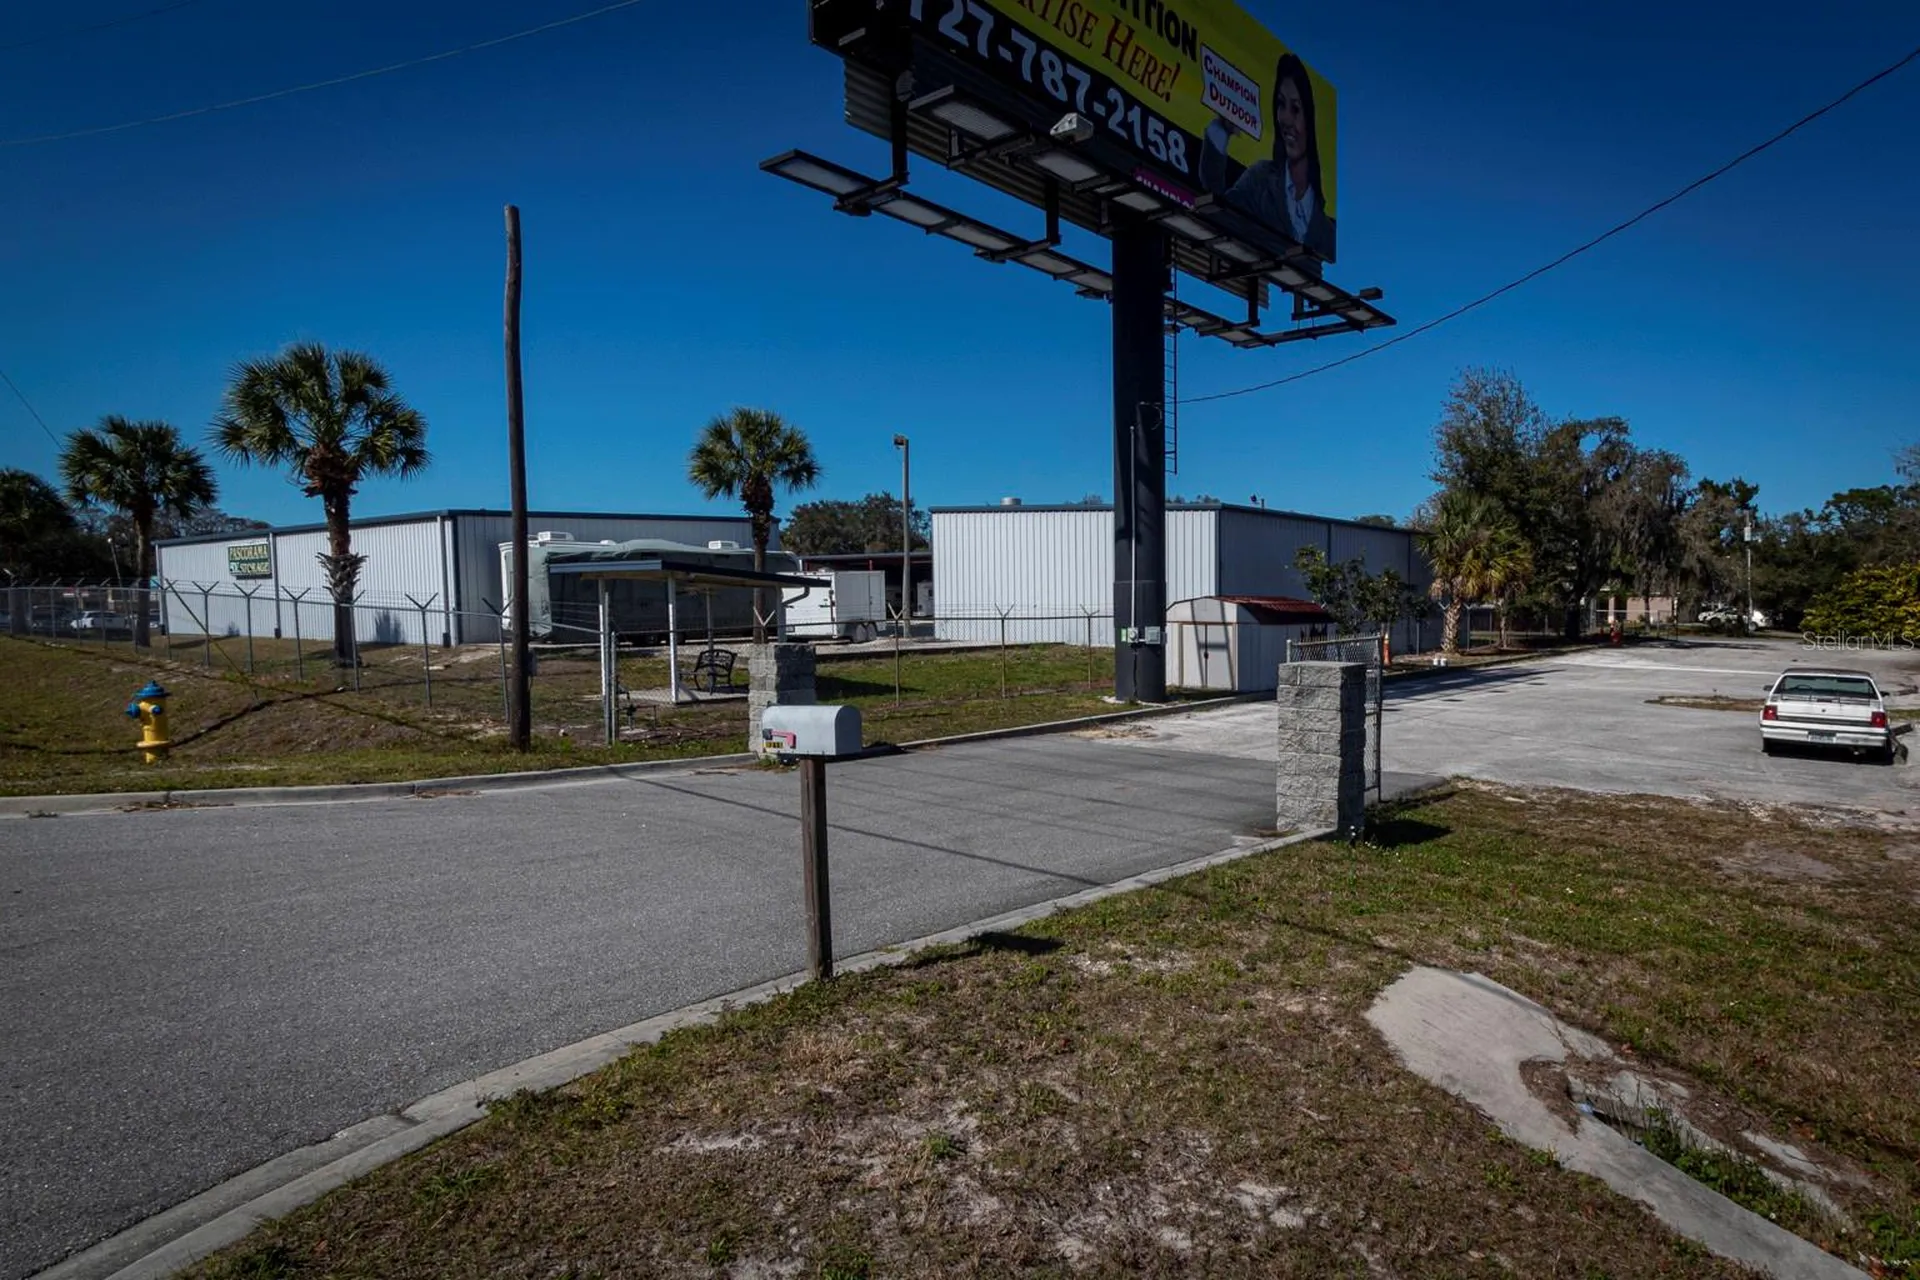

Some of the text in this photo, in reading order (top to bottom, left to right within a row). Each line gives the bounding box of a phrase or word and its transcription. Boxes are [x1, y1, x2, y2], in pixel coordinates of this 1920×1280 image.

[1101, 15, 1181, 103] HERE!
[1204, 54, 1257, 106] CHAMPION
[1209, 81, 1258, 130] OUTDOOR
